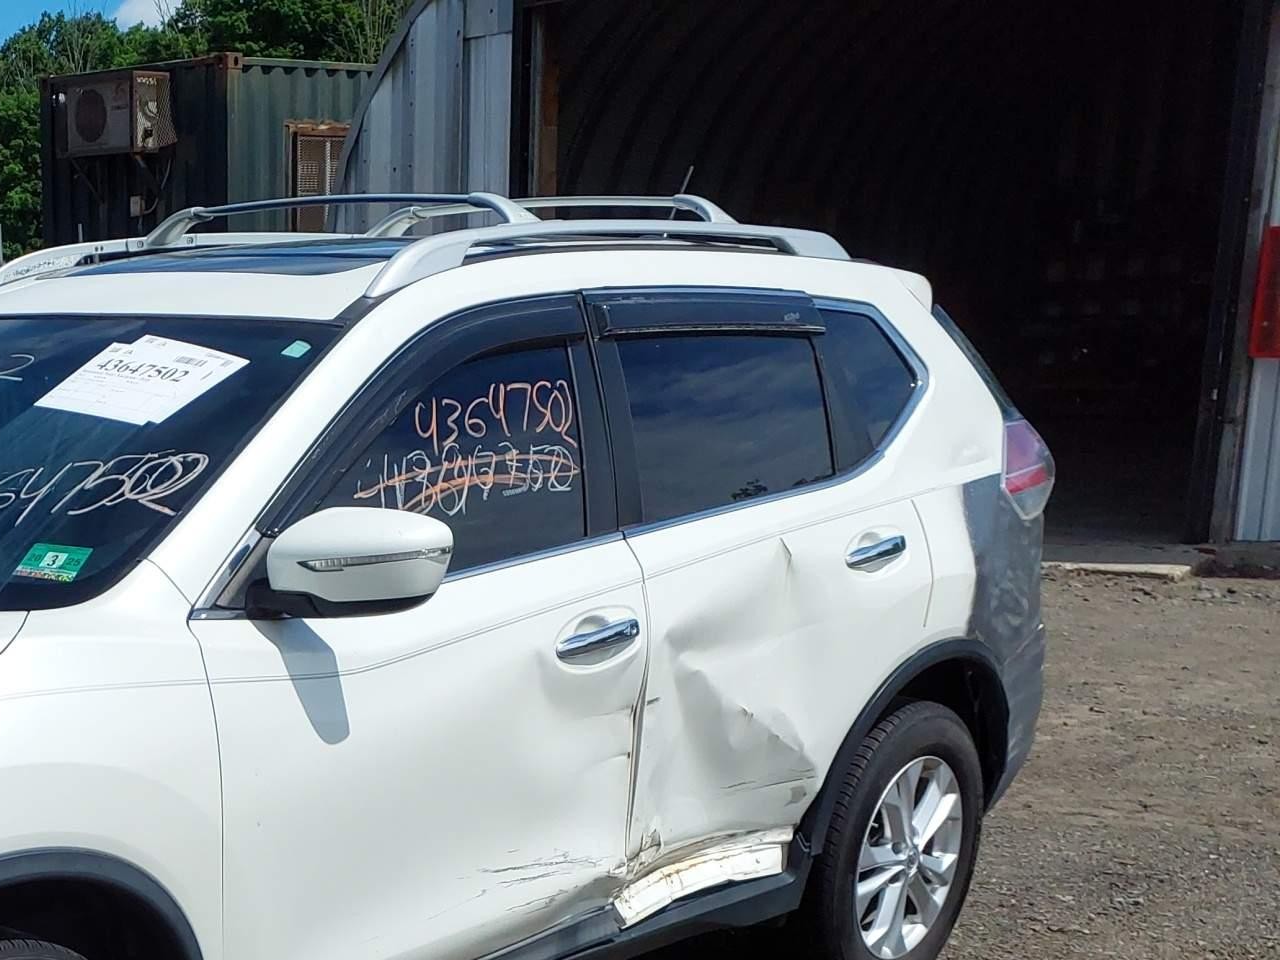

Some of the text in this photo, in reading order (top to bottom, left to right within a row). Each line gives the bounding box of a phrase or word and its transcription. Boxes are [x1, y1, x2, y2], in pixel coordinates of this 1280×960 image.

[97, 358, 190, 383] 43647502
[415, 380, 577, 456] 43647502
[46, 554, 60, 567] 3
